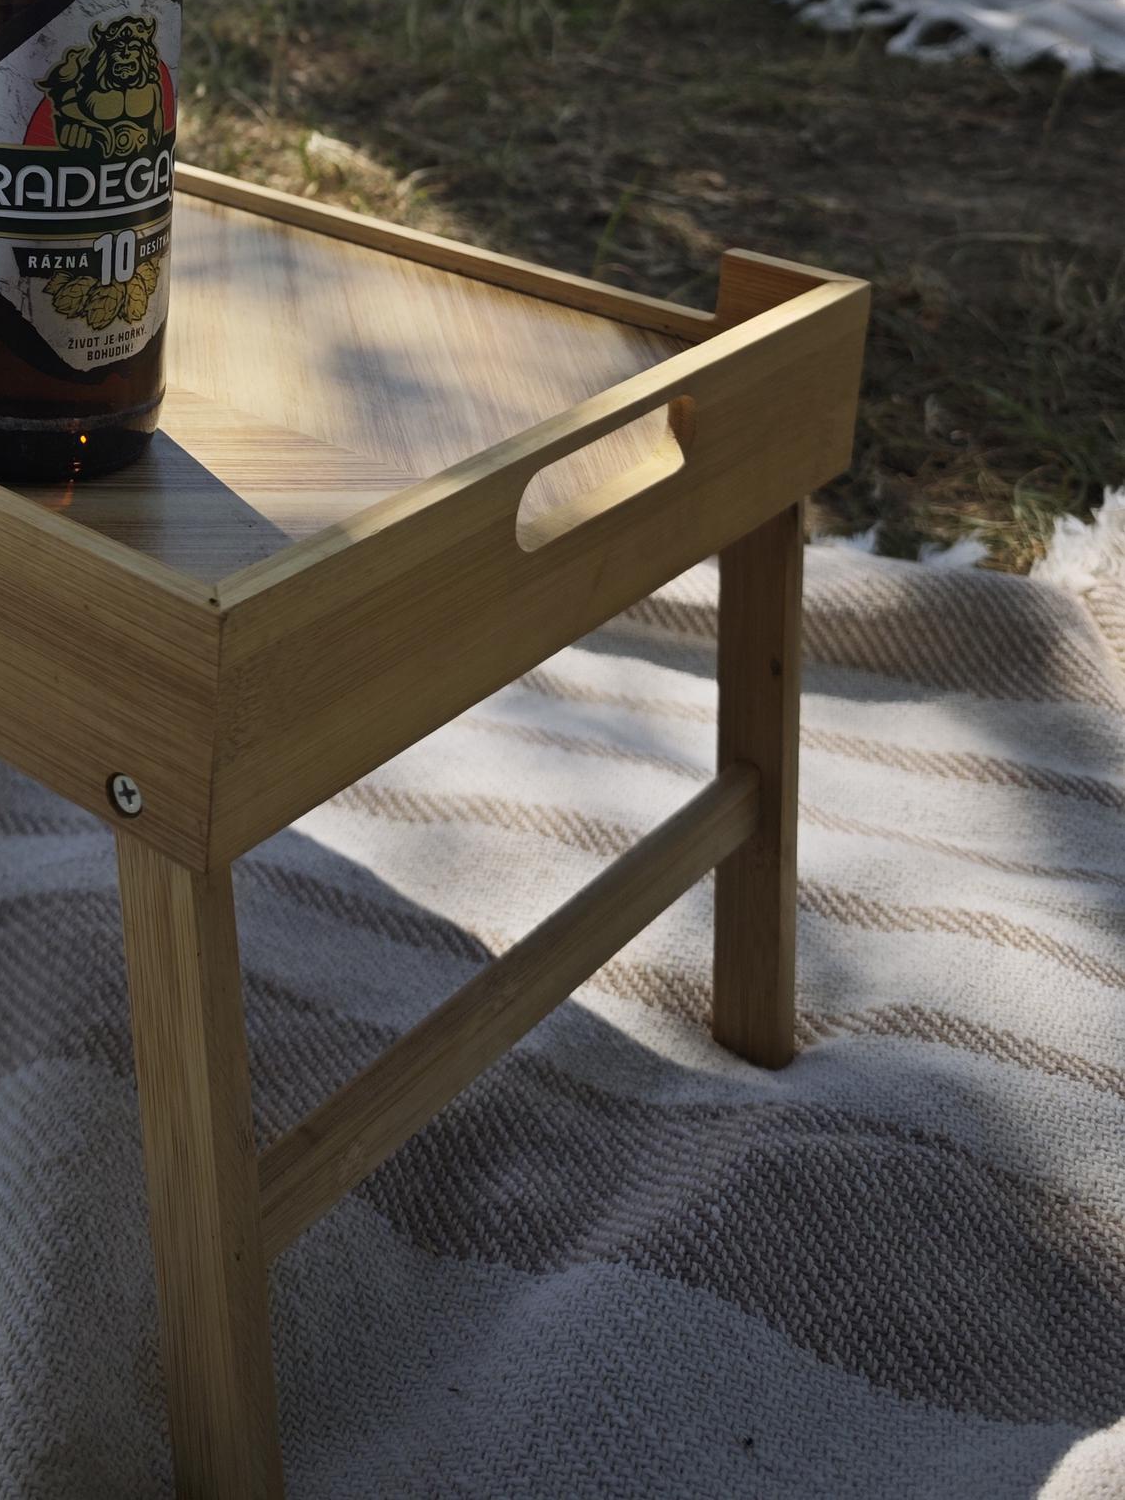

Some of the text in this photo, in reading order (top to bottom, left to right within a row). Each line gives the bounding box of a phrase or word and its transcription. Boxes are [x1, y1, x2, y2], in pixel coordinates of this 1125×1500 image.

[28, 252, 90, 270] RÁZNÁ
[93, 229, 135, 286] 10
[68, 336, 100, 350] ŽIVOT
[104, 334, 115, 346] JE
